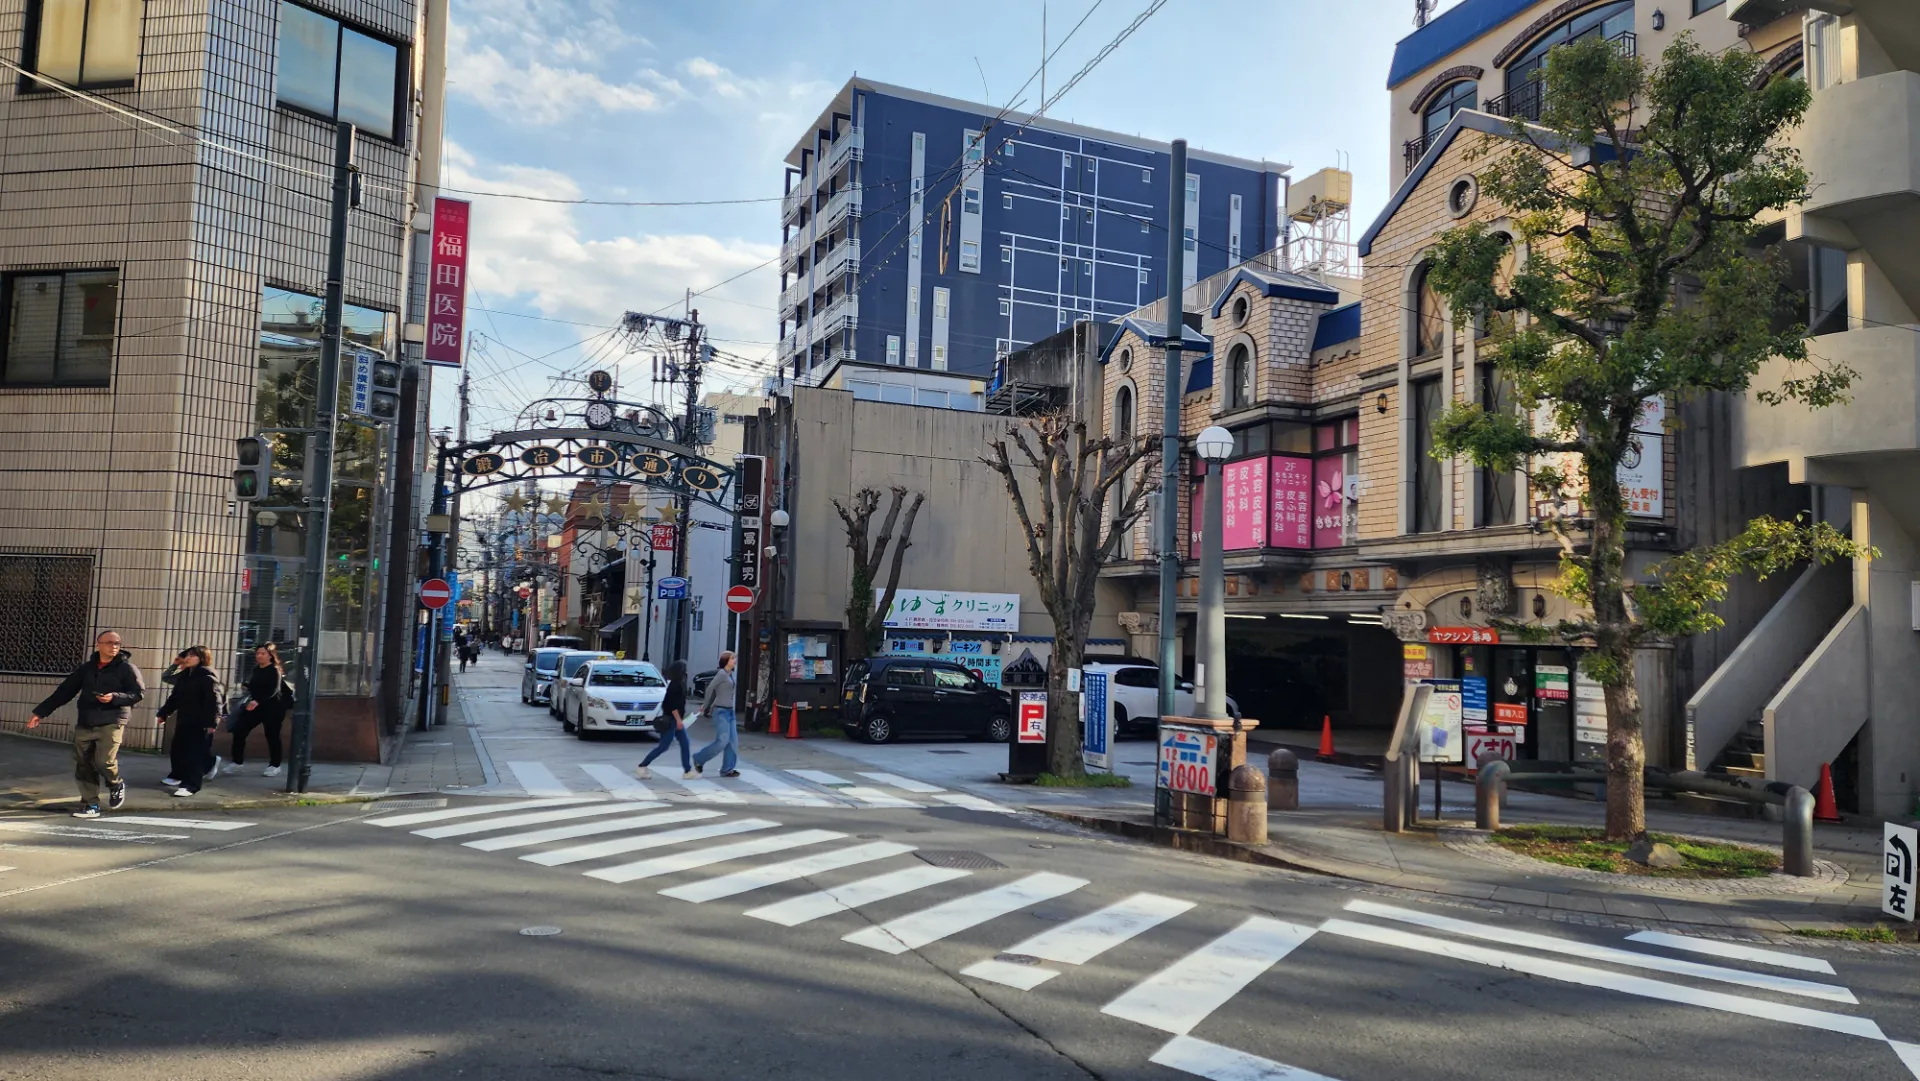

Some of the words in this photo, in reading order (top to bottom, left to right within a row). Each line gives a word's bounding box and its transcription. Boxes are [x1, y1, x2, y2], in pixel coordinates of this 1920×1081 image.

[432, 232, 462, 347] 福田医院
[355, 355, 369, 410] 斜め横断専用
[475, 450, 707, 485] 鍛冶市通り
[1284, 462, 1297, 472] 2F
[1226, 468, 1236, 528] 形成外科
[1239, 466, 1250, 512] 皮ふ科
[1252, 463, 1264, 542] 美容皮膚科
[1274, 489, 1285, 533] 形成外科
[1286, 491, 1297, 523] 皮ふ科
[1297, 491, 1308, 546] 美容皮膚科
[900, 593, 1015, 616] ゆずクリニック
[892, 641, 899, 650] P
[1433, 630, 1492, 643] ヤクシン薬局
[1021, 704, 1045, 732] P
[1206, 735, 1216, 755] P
[1471, 738, 1514, 761] くすり
[1889, 884, 1907, 914] 左
